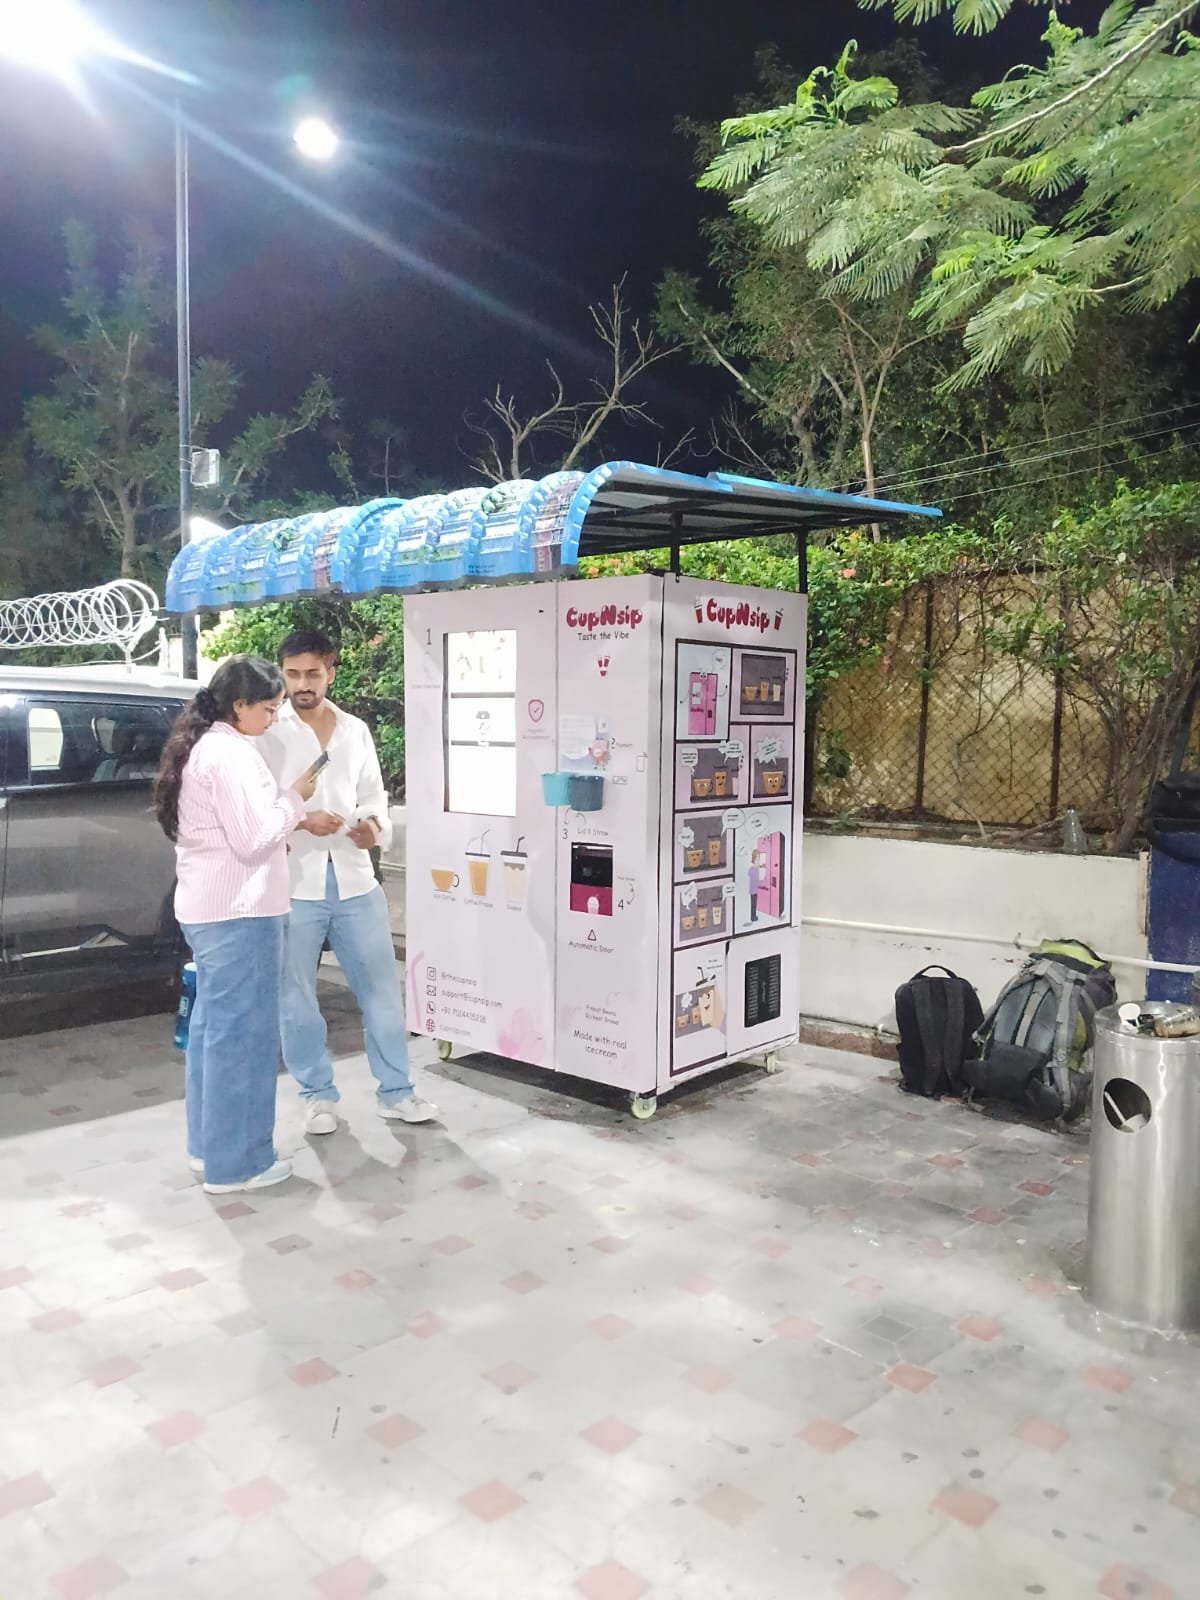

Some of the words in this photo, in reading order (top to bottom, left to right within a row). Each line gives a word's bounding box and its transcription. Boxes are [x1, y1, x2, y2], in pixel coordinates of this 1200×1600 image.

[565, 604, 643, 631] CupNsip
[706, 598, 770, 633] CupNsip
[426, 628, 432, 645] 1
[577, 632, 597, 641] Taste
[599, 631, 611, 640] the
[614, 630, 629, 640] Vibe
[561, 828, 568, 840] 3
[617, 899, 625, 910] 4
[568, 940, 599, 952] Automatic
[573, 1029, 593, 1042] Made
[595, 1035, 611, 1046] with
[612, 1040, 627, 1050] real
